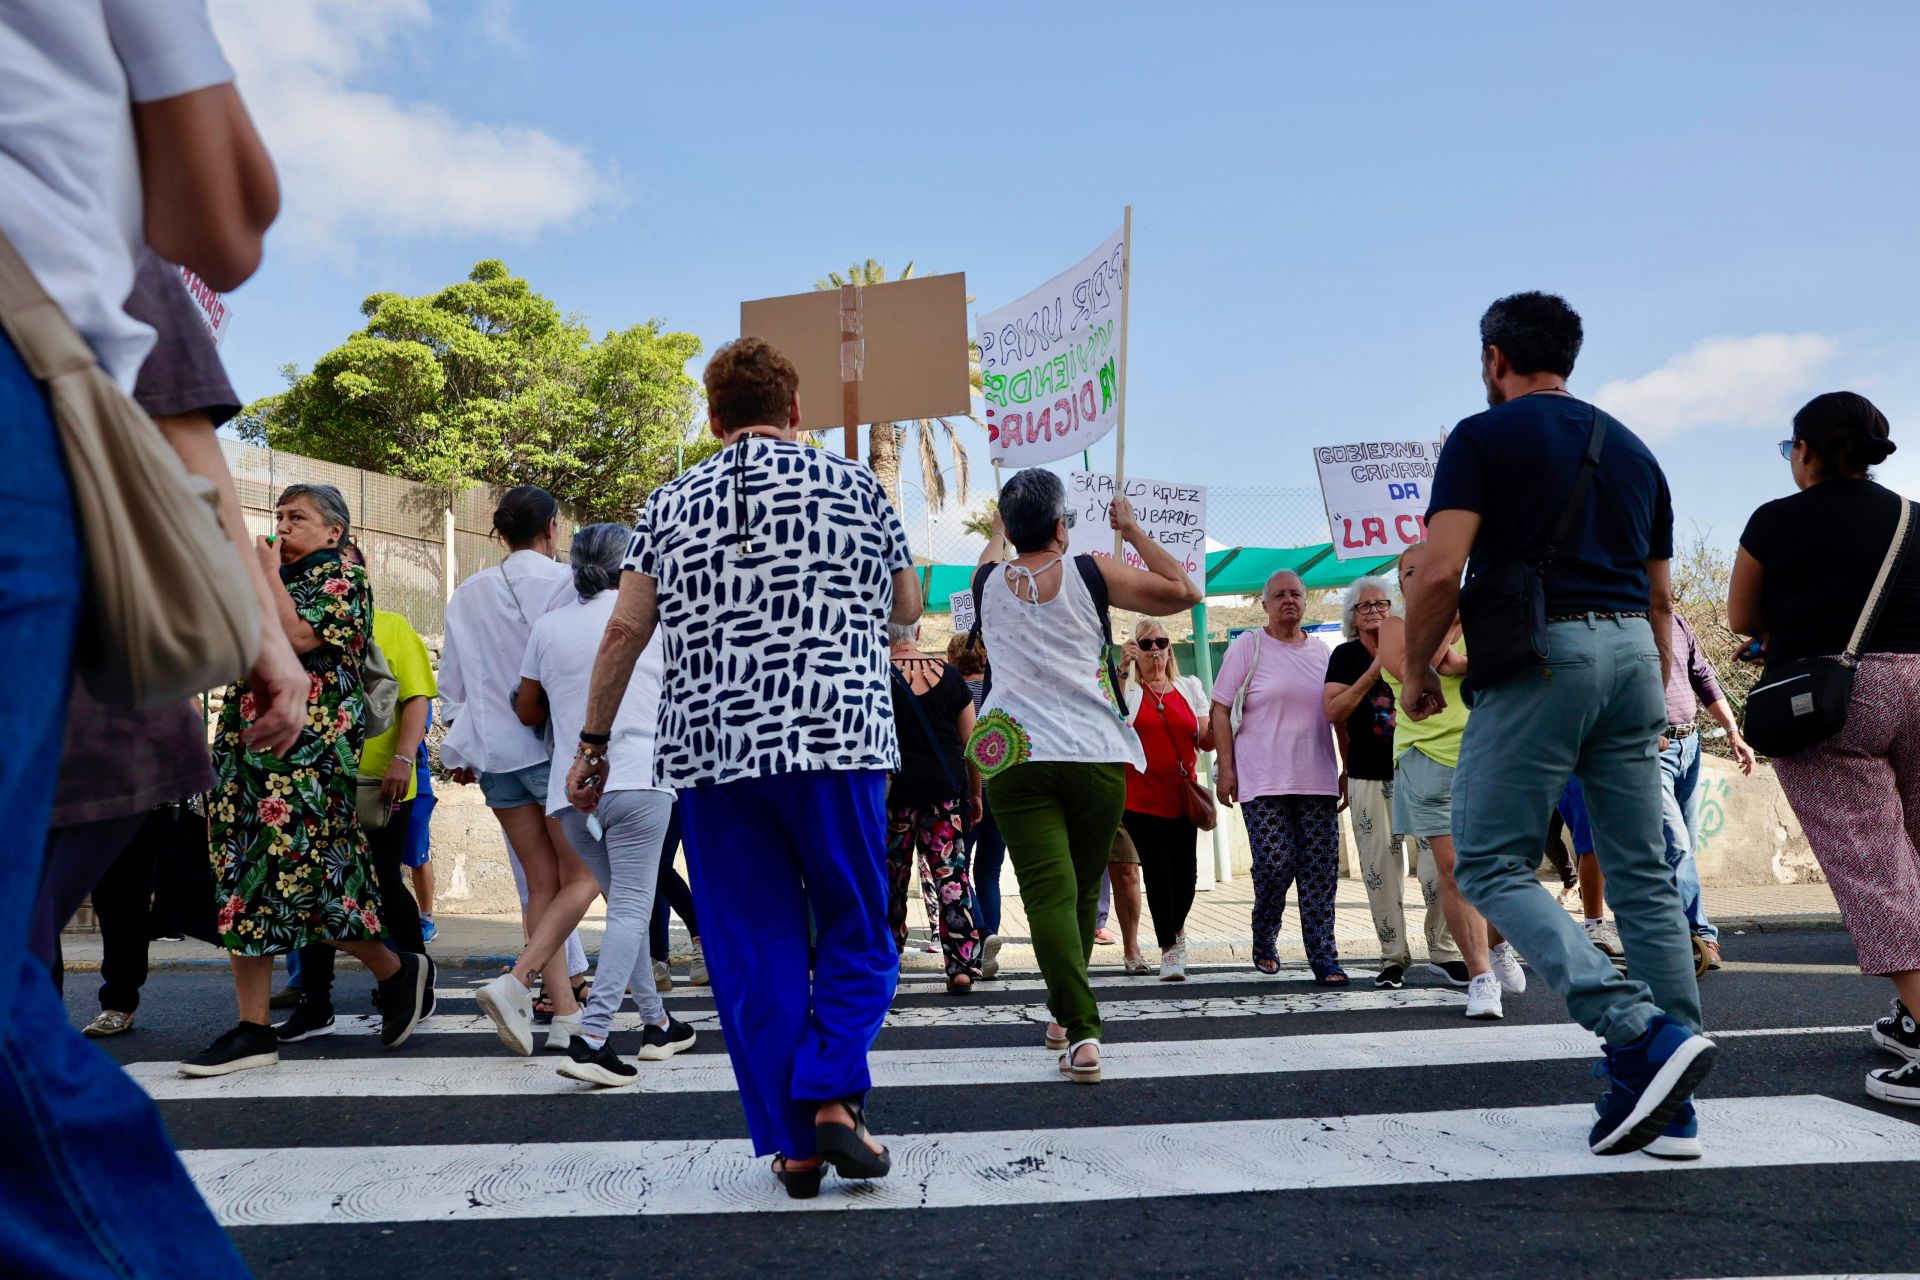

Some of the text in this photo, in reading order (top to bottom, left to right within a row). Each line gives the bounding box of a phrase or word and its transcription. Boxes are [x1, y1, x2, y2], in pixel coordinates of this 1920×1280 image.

[1319, 442, 1424, 464] GOBIERNO
[1351, 462, 1438, 483] CANARI
[1098, 475, 1146, 497] PALO
[1388, 482, 1420, 500] DA
[1150, 508, 1198, 527] BARRIO
[1159, 528, 1205, 552] ESTE?
[953, 593, 975, 612] PO
[954, 612, 977, 631] BA
